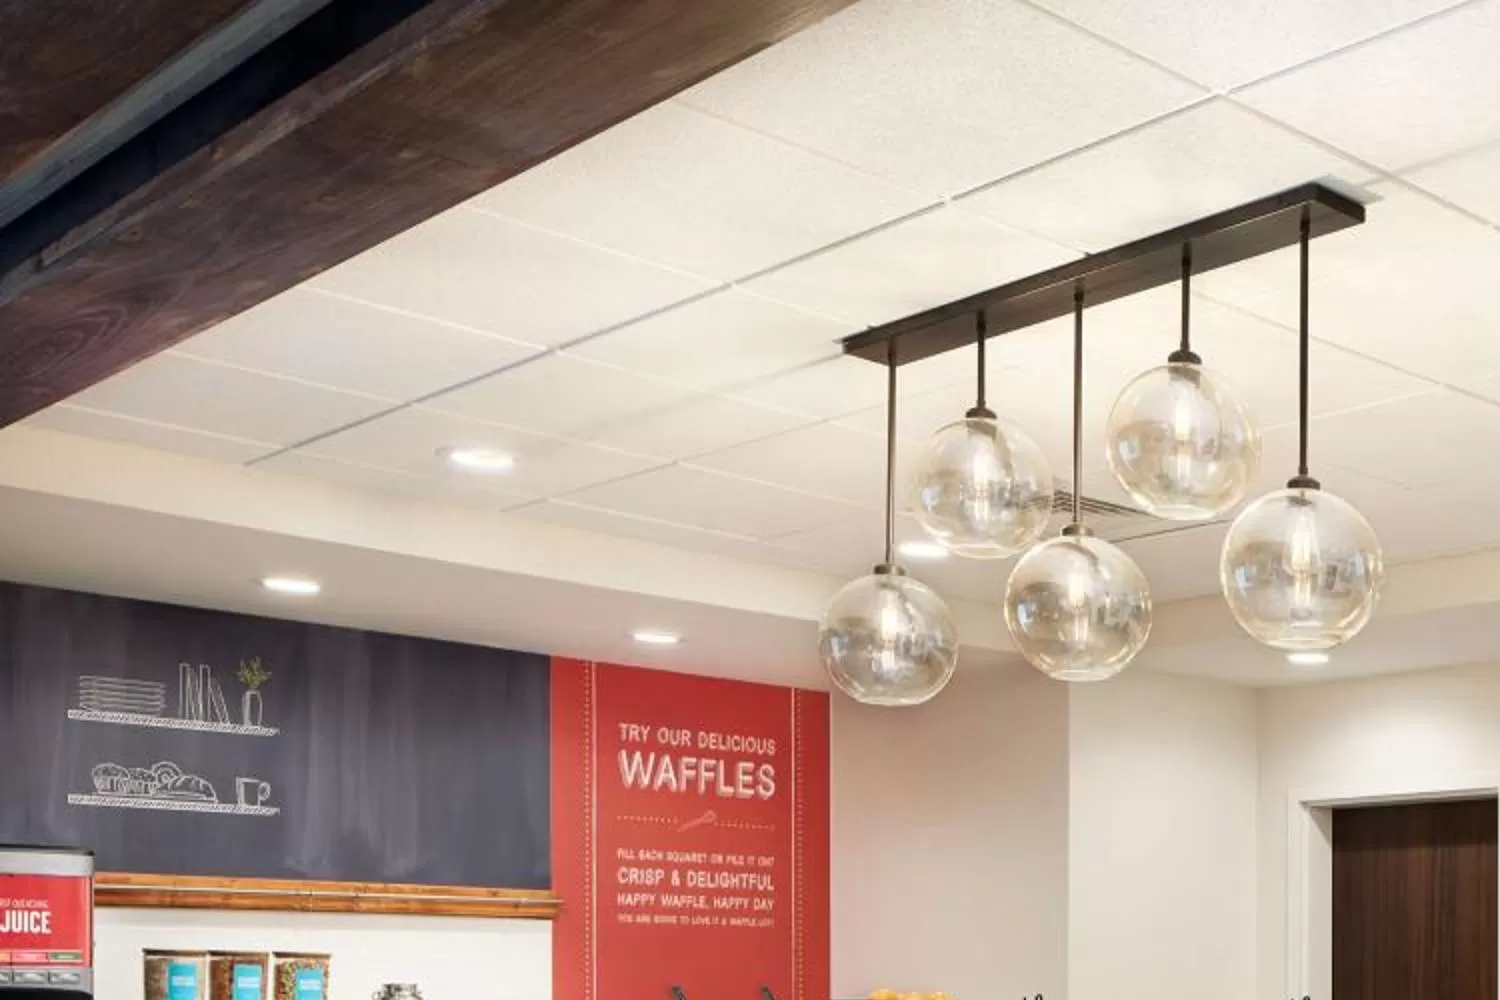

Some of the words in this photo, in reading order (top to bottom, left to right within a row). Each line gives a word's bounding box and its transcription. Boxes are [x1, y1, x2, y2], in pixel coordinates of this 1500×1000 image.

[618, 723, 651, 743] TRY
[657, 727, 691, 748] OUR
[698, 731, 776, 756] DELICIOUS
[617, 749, 776, 800] WAFFLES
[617, 866, 665, 886] CRISP
[671, 869, 680, 887] &
[687, 870, 775, 891] DELIGHTFUL
[617, 892, 656, 906] HAPPY
[713, 896, 749, 910] HAPPY
[753, 898, 774, 911] DAY
[0, 910, 52, 933] JUICE
